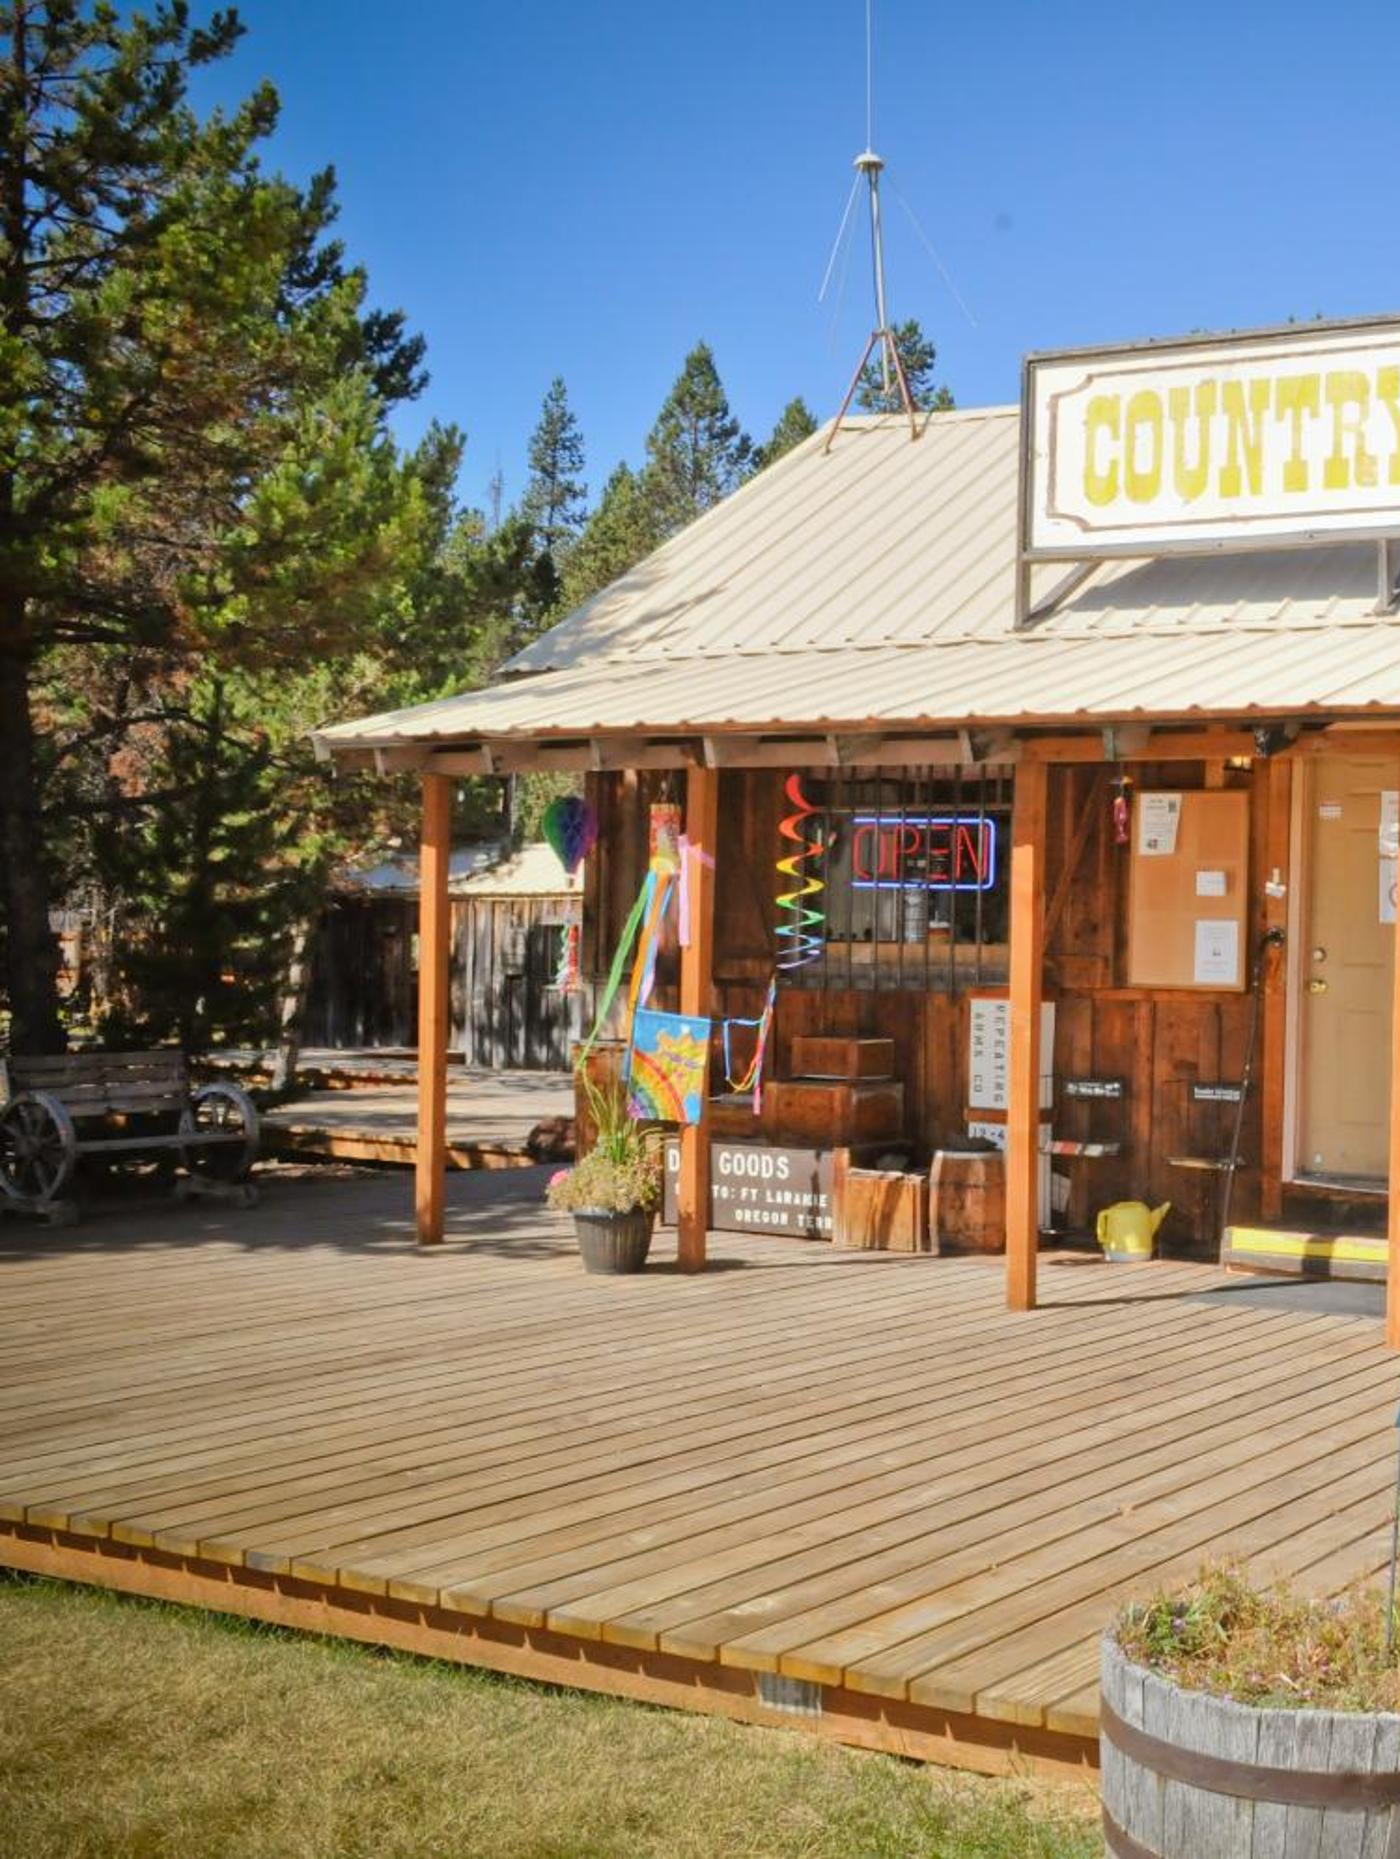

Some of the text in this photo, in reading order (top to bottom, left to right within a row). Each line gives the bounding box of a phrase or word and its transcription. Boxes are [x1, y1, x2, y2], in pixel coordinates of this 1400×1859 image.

[852, 823, 989, 881] OPEN
[719, 1151, 790, 1179] GOODS
[740, 1187, 759, 1202] FT
[766, 1190, 828, 1207] LARAMIE
[734, 1208, 789, 1225] OREGON
